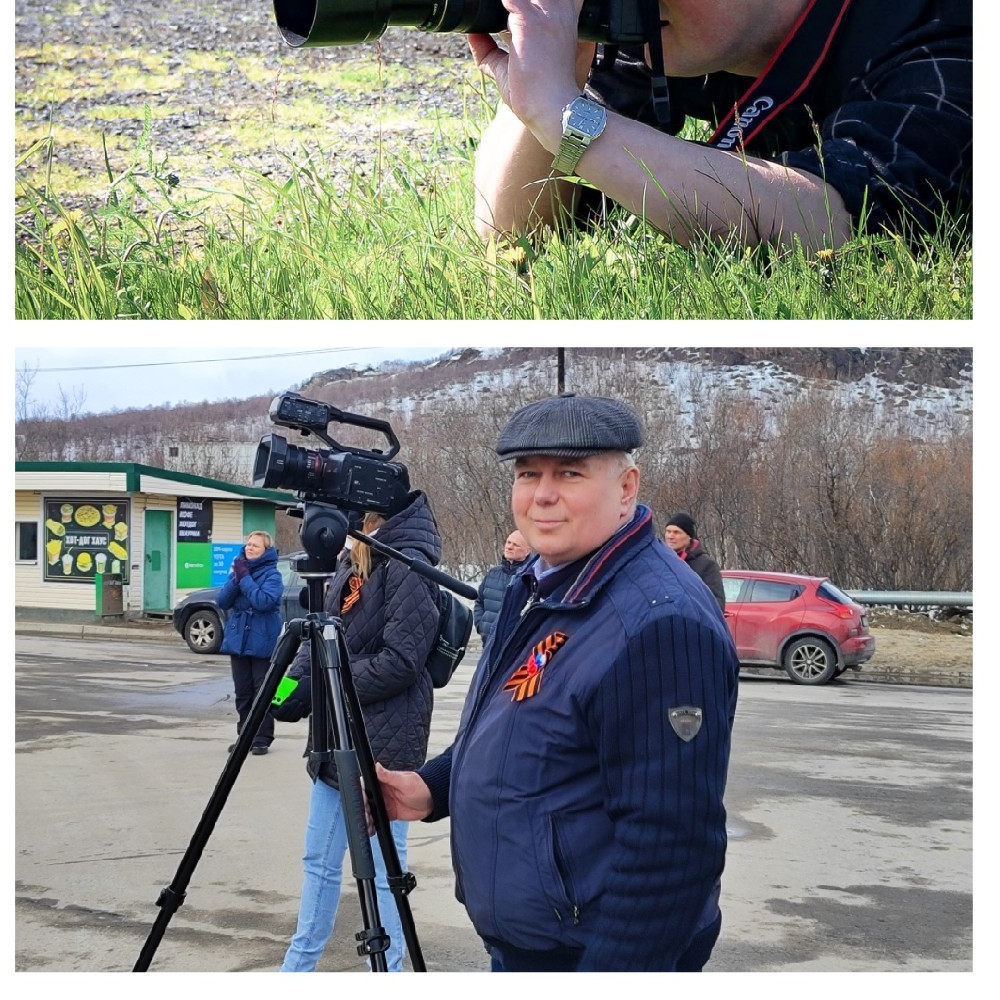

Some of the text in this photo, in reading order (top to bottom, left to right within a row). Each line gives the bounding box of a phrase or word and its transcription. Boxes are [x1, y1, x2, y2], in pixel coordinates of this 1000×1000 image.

[717, 96, 774, 149] Canon
[65, 535, 107, 546] ХОТ-ДОГ ХАУС
